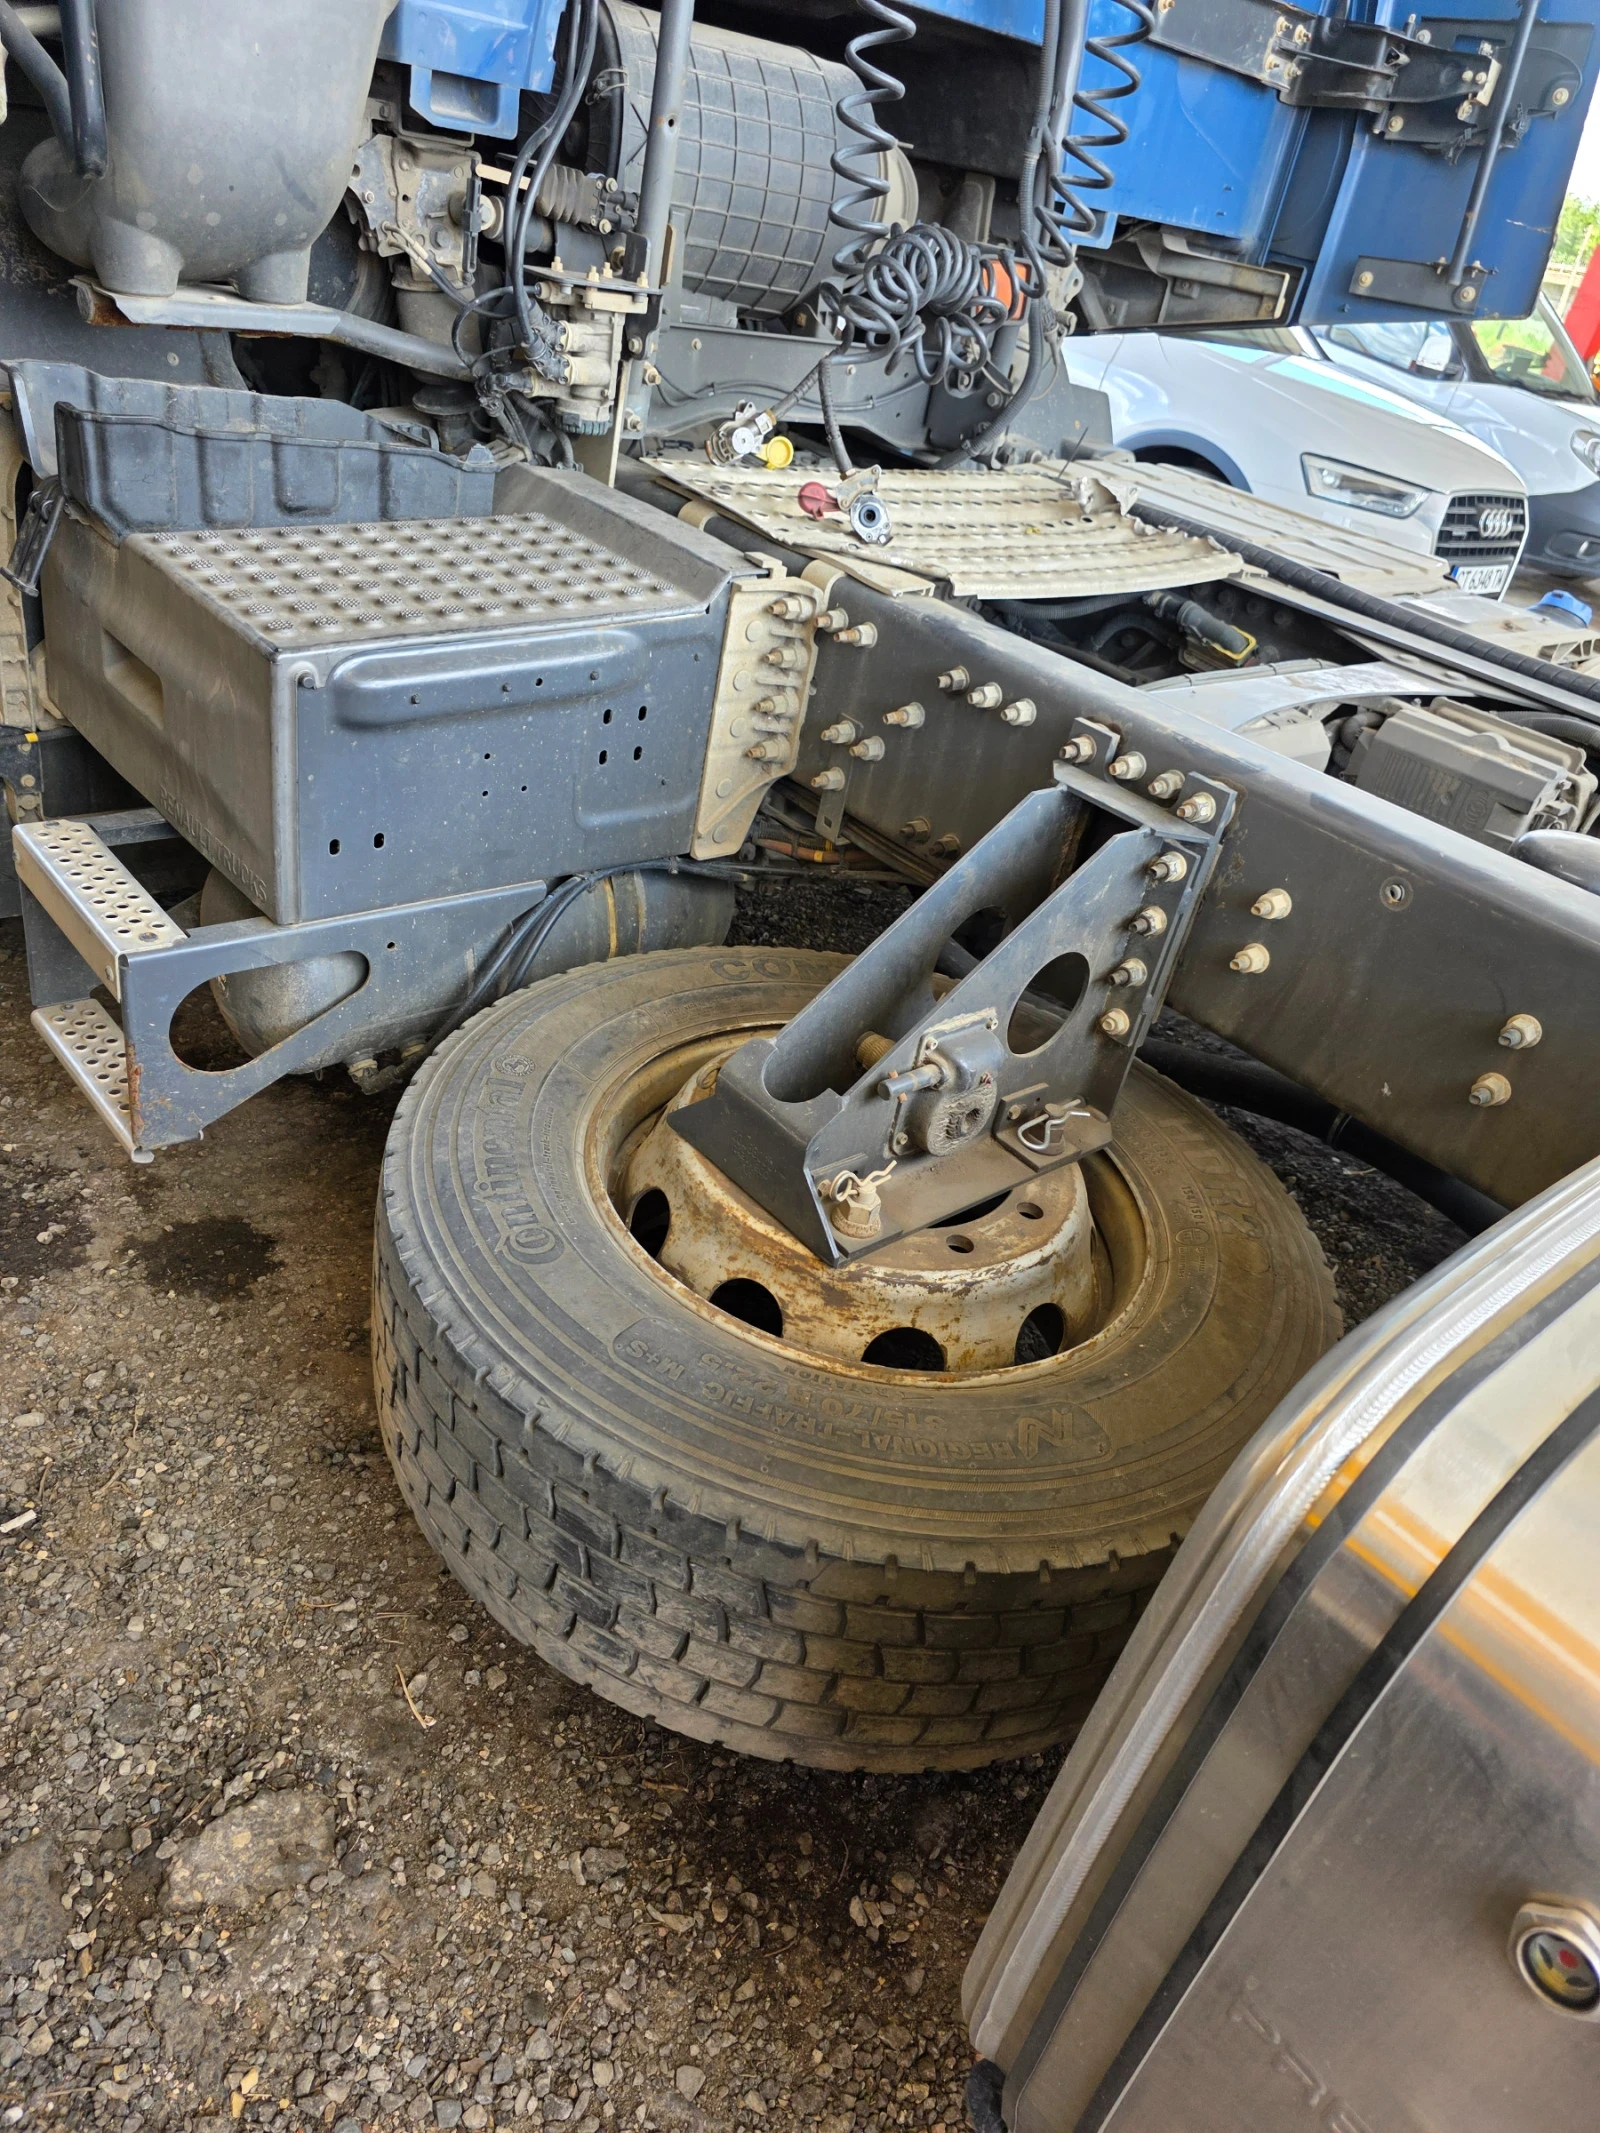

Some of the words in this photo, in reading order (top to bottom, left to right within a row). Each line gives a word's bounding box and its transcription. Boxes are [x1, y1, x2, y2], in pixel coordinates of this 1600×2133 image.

[1468, 569, 1492, 590] 6348
[160, 783, 212, 854] RENAULT
[214, 836, 267, 902] TRUCKS
[473, 1077, 565, 1265] Continental
[626, 1340, 685, 1381] M+S
[698, 1353, 779, 1395] 22.5
[822, 1398, 948, 1432] 315/70
